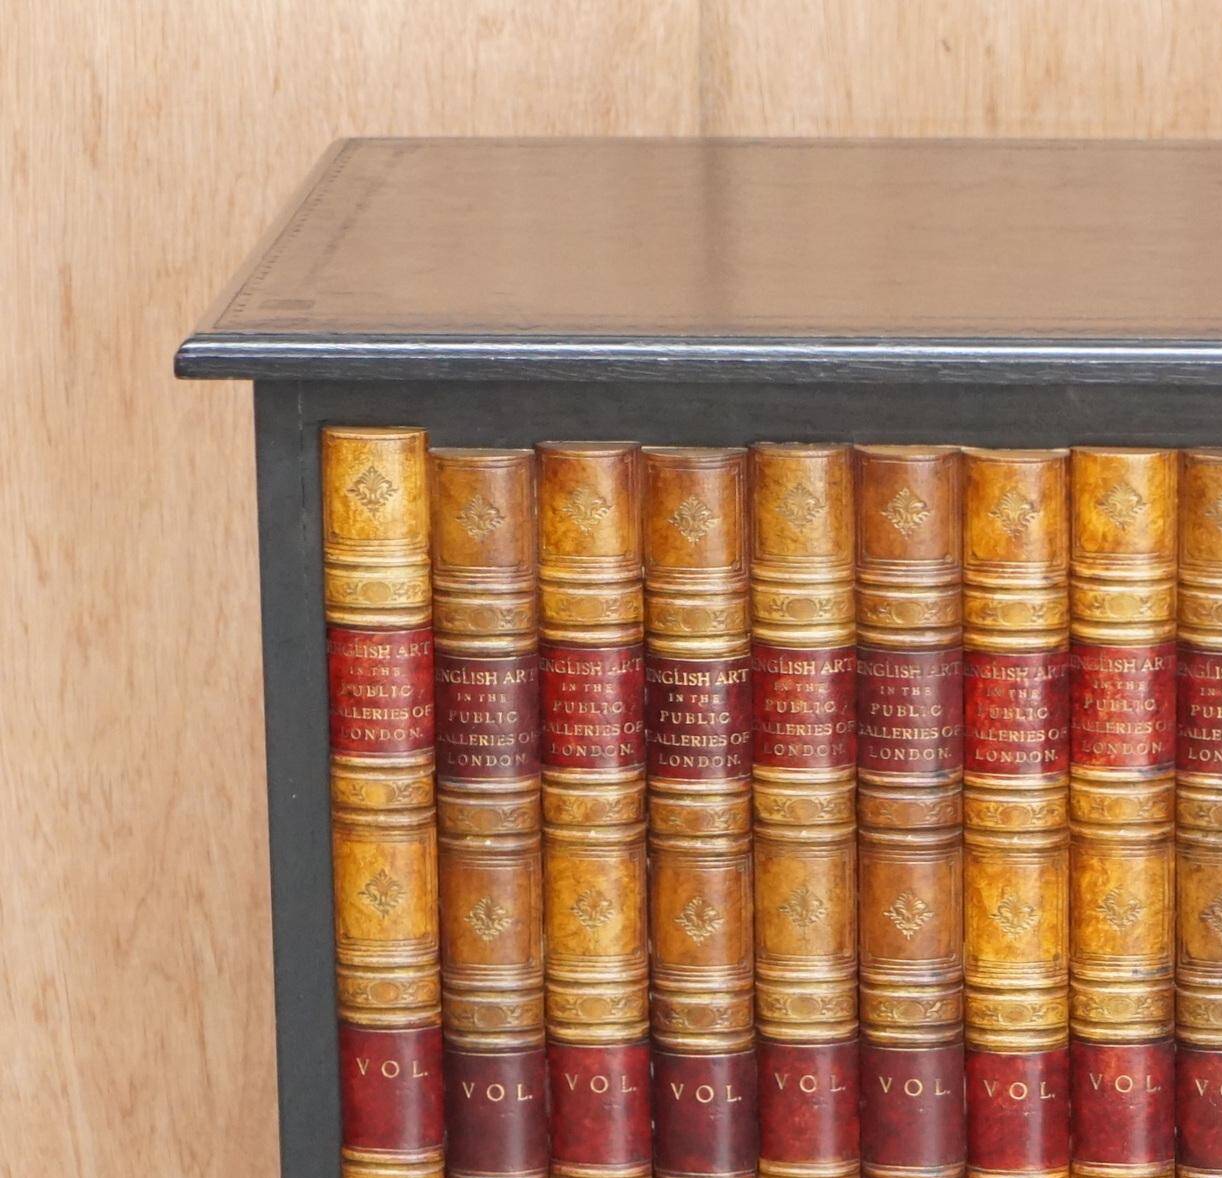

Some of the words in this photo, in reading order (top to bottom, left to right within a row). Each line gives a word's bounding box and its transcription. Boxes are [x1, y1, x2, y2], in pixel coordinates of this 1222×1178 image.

[647, 667, 710, 687] ENGLISH
[716, 668, 749, 685] ART
[448, 710, 518, 724] PUBLIC
[553, 701, 623, 714] PUBLIC
[871, 704, 941, 717] PUBLIC
[659, 710, 730, 725] PUBLIC
[659, 755, 741, 768] LONDON.
[975, 749, 1058, 763] LONDON.
[356, 1058, 428, 1077] VOL.
[463, 1081, 532, 1101] VOL.
[565, 1073, 636, 1092] VOL.
[775, 1072, 845, 1092] VOL.
[879, 1076, 949, 1096] VOL.
[983, 1079, 1054, 1100] VOL.
[1090, 1073, 1160, 1092] VOL.
[671, 1082, 741, 1102] VOL.
